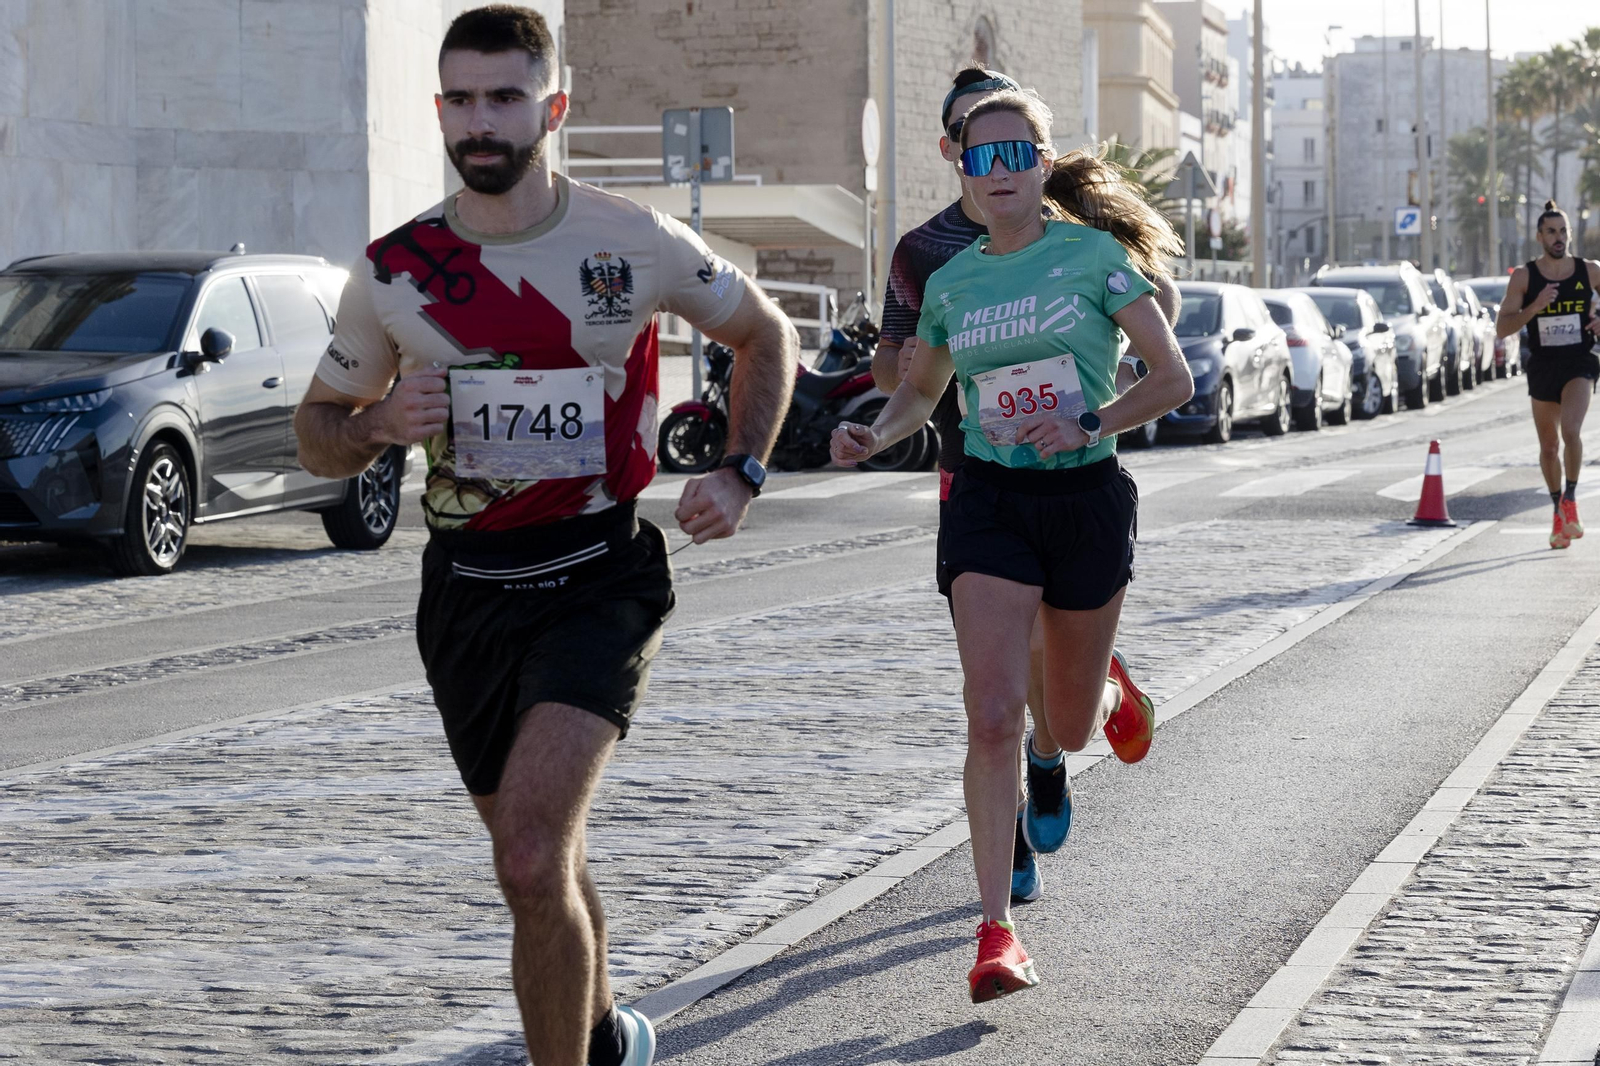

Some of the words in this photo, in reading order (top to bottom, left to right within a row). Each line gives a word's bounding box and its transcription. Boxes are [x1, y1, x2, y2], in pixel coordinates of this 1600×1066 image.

[962, 295, 1037, 328] MEDIA
[984, 337, 1039, 353] CHICLANA
[1545, 323, 1575, 336] 1772
[997, 382, 1059, 419] 935
[473, 402, 584, 441] 1748
